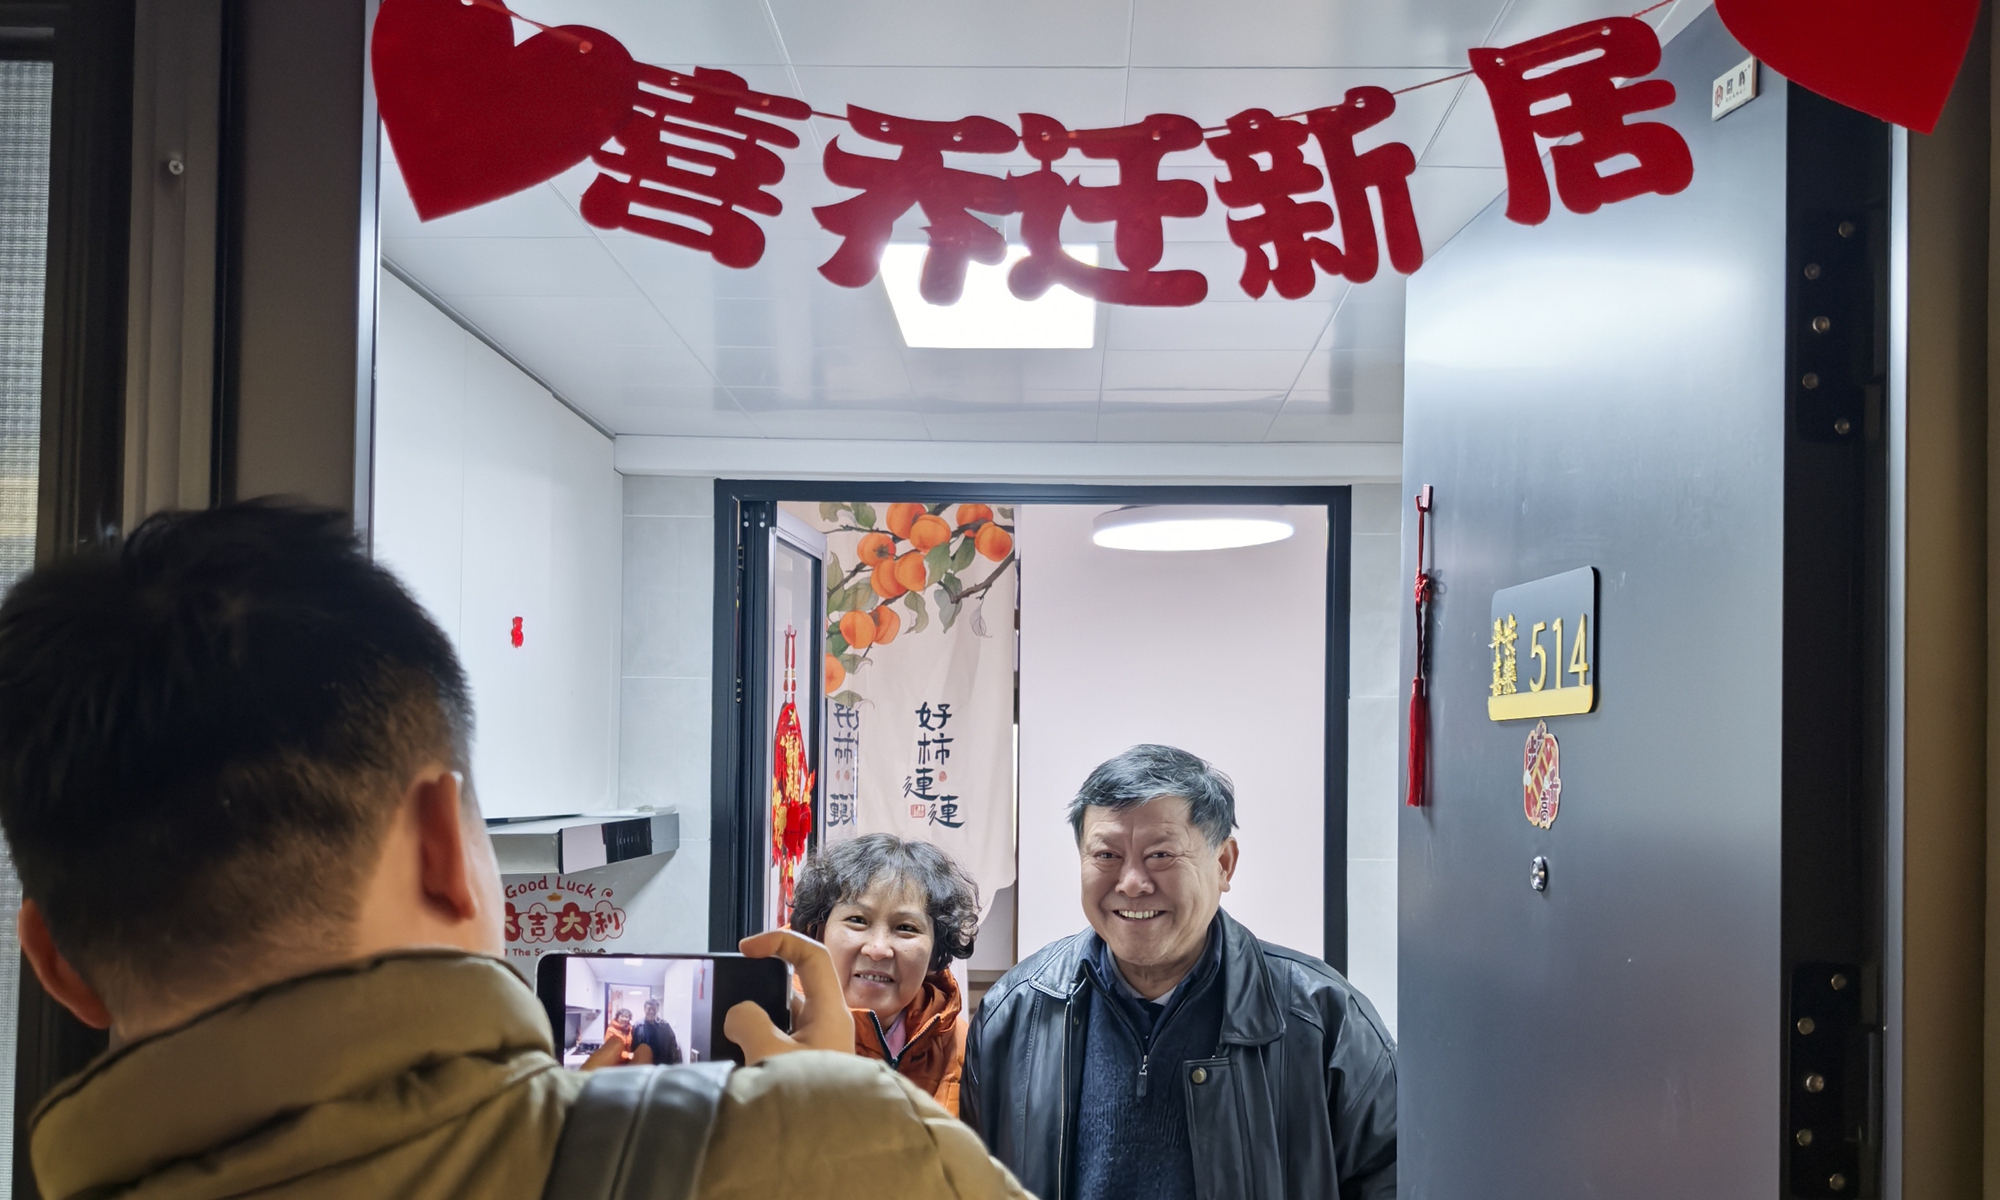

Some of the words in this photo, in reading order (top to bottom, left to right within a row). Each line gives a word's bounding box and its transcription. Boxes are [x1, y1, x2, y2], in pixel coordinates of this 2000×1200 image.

[580, 15, 1694, 307] 喜乔迁新居
[1529, 612, 1589, 693] 514
[505, 875, 549, 899] Good
[556, 875, 597, 900] Luck
[512, 948, 531, 957] The
